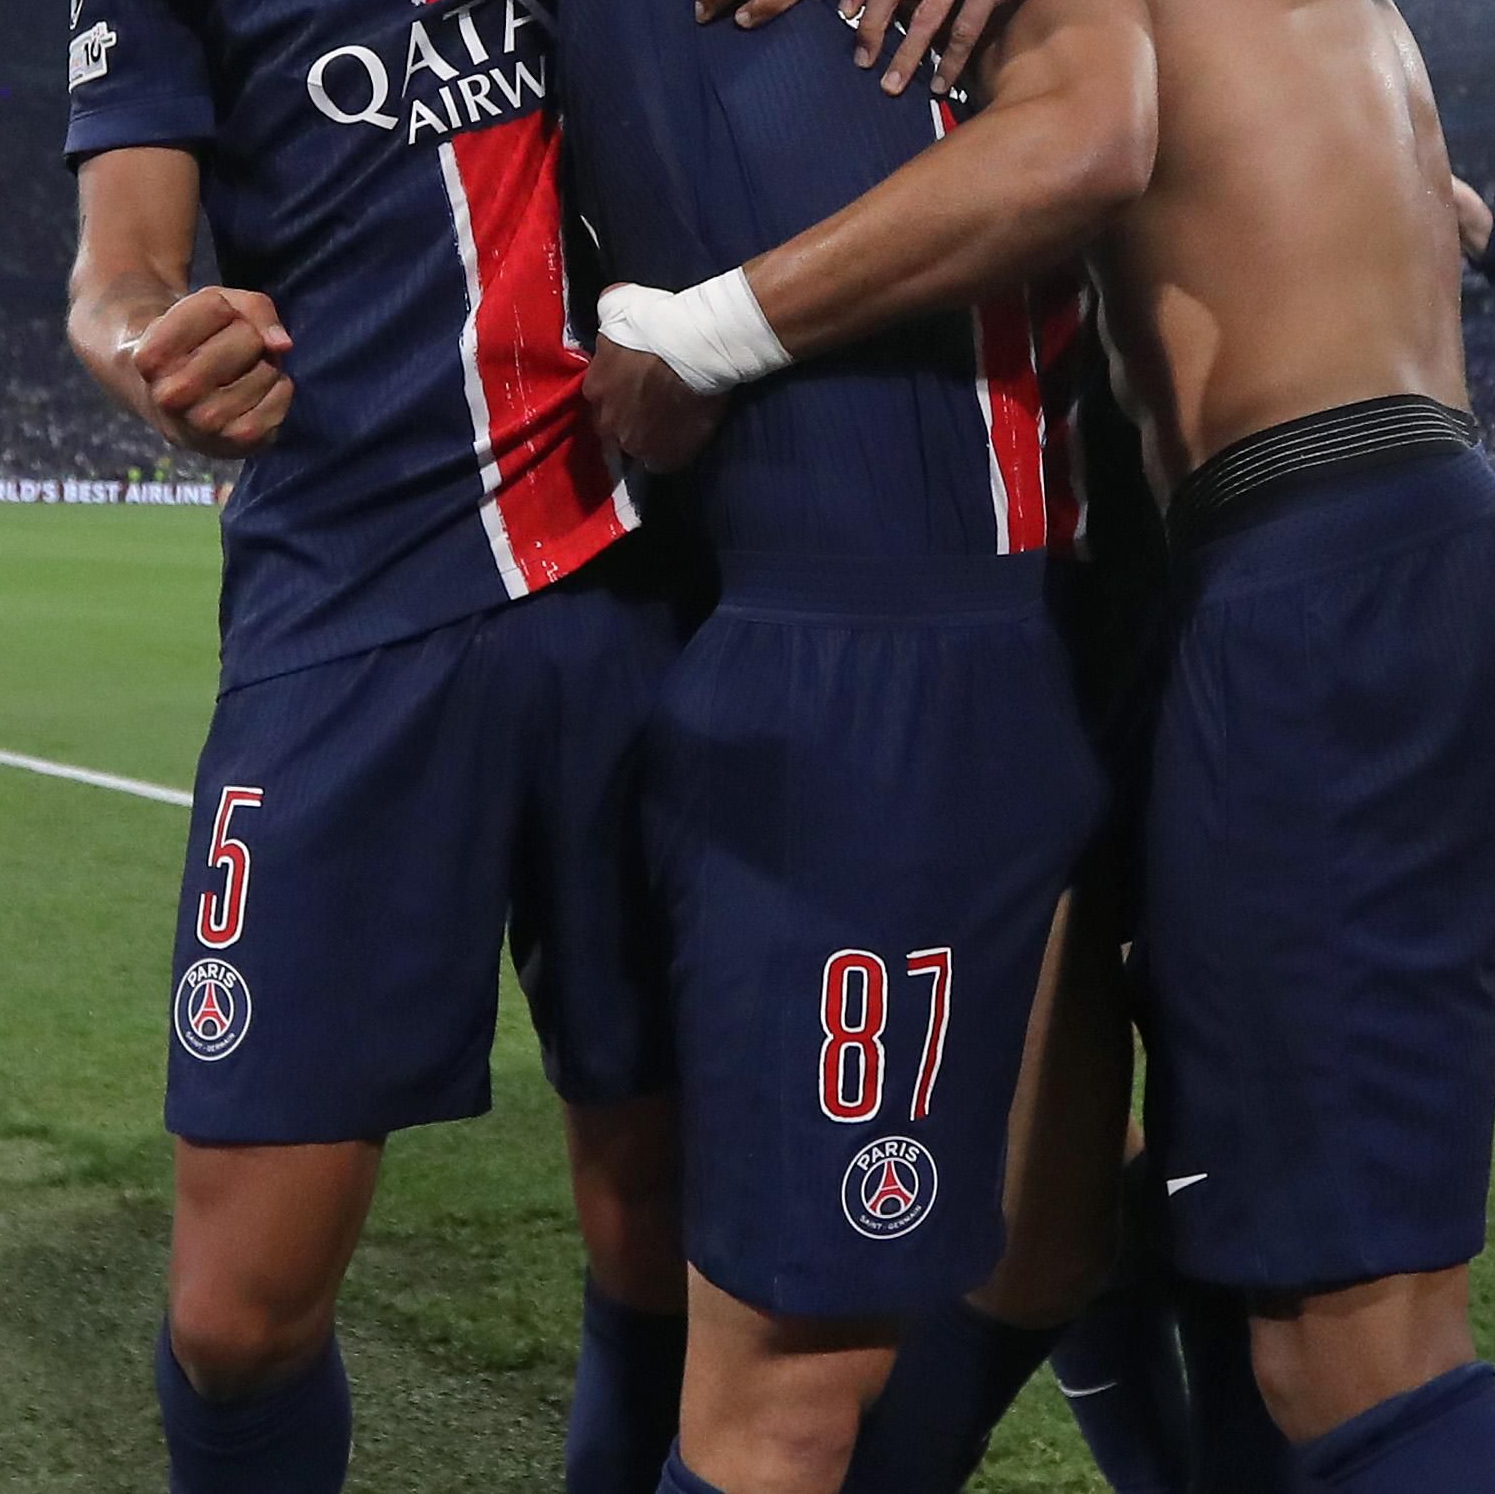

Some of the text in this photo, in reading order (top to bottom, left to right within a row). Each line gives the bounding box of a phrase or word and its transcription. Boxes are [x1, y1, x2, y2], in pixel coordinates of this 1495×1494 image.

[408, 55, 546, 145] AIRW
[62, 481, 121, 504] BEST
[125, 482, 216, 506] AIRLINE
[197, 786, 264, 949] 5
[187, 963, 236, 988] PARIS
[819, 947, 952, 1123] 87
[856, 1141, 920, 1171] PARIS
